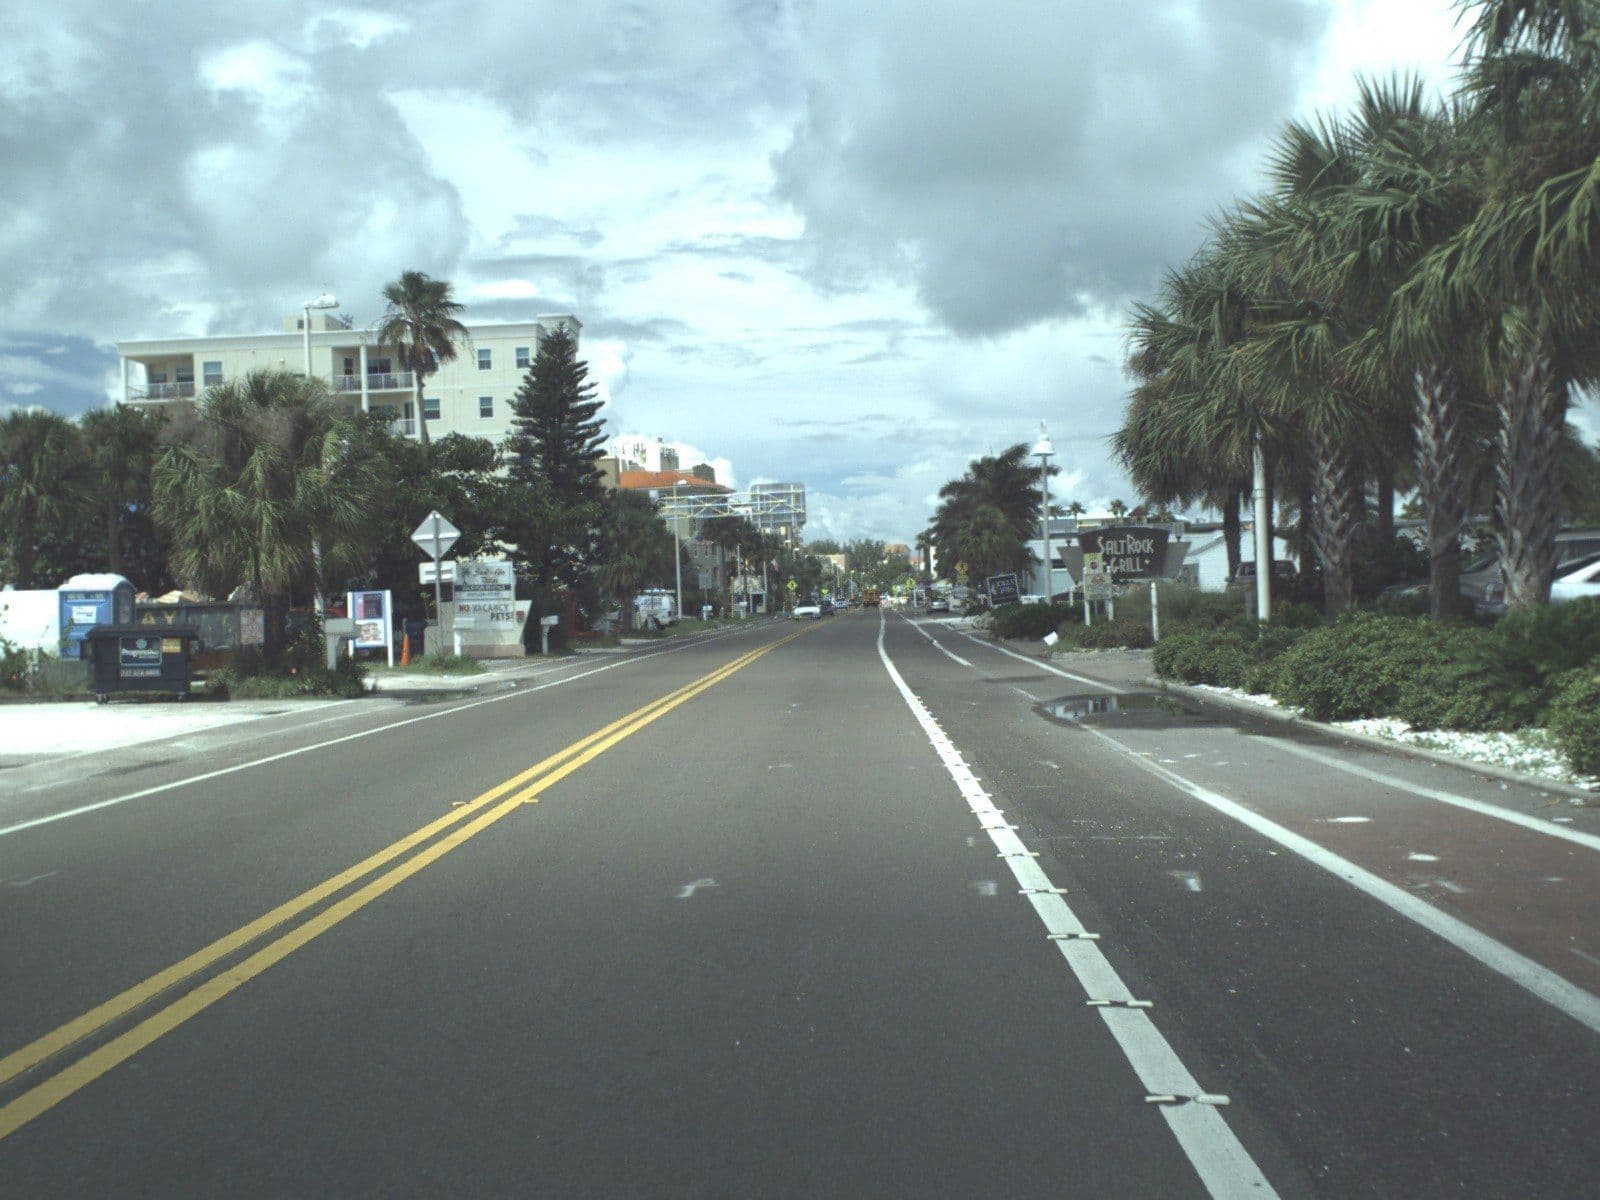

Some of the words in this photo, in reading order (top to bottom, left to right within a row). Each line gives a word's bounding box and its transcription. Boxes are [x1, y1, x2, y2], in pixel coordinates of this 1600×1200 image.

[1110, 557, 1144, 574] GRILL
[458, 603, 470, 613] NO
[472, 603, 509, 613] VACANCY
[490, 612, 511, 621] PETS
